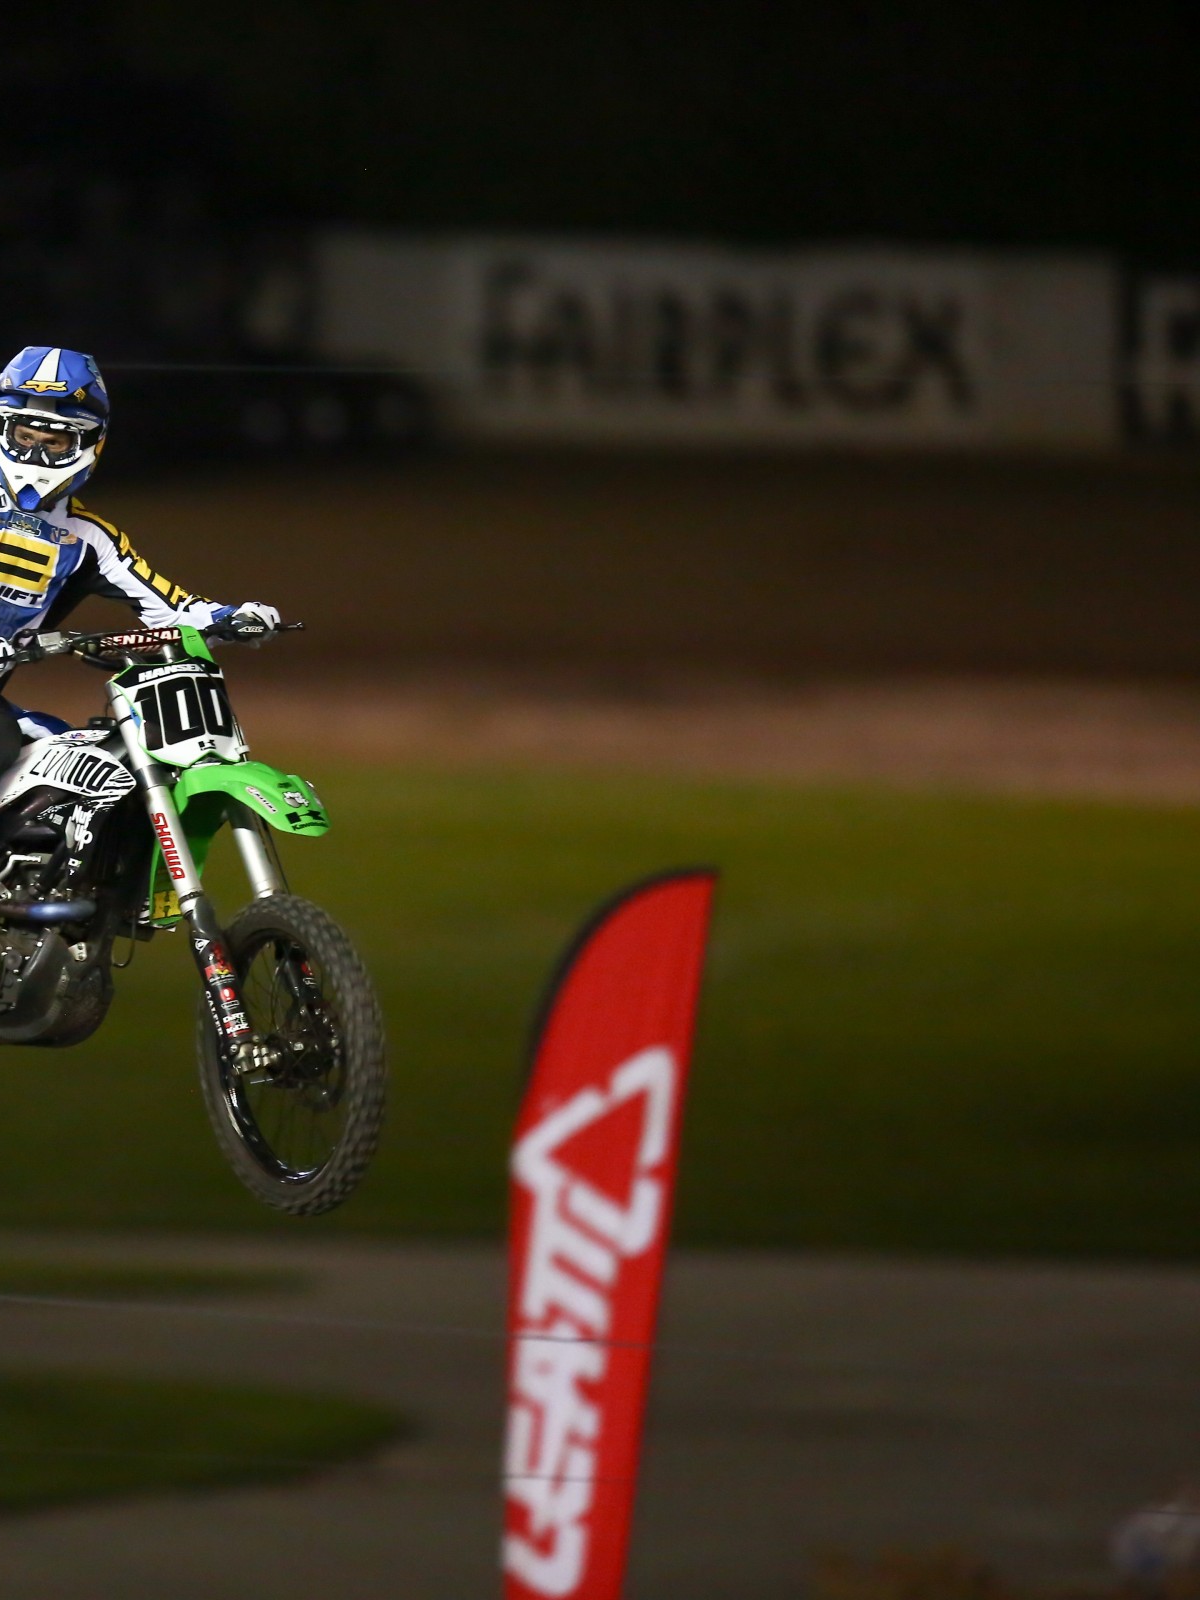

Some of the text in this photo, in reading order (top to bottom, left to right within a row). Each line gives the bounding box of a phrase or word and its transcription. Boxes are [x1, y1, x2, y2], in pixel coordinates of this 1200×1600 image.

[238, 625, 264, 633] ARC
[138, 663, 206, 683] HANSEN
[133, 676, 234, 751] 100
[151, 812, 186, 880] SHOWA
